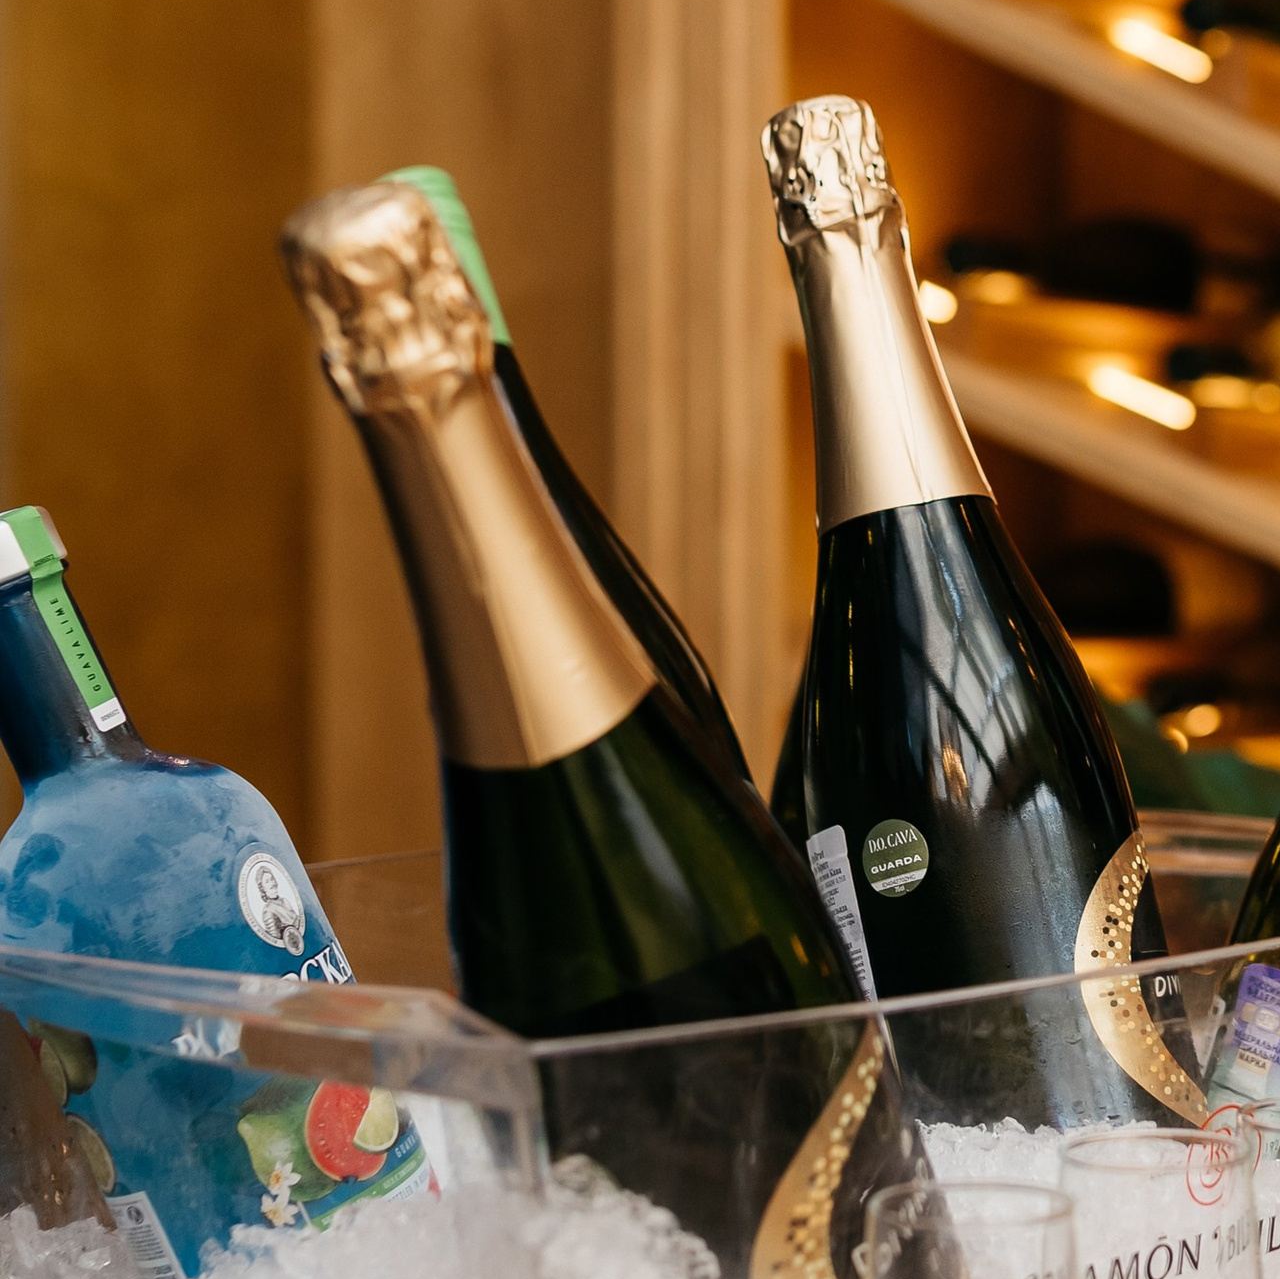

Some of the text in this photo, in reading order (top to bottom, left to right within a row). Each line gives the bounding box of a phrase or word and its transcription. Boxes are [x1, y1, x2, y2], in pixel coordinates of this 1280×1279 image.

[49, 597, 102, 692] GUAVA LIME
[887, 828, 918, 848] CAVA
[870, 854, 922, 874] GUARDA
[1238, 1052, 1267, 1070] МАРКА
